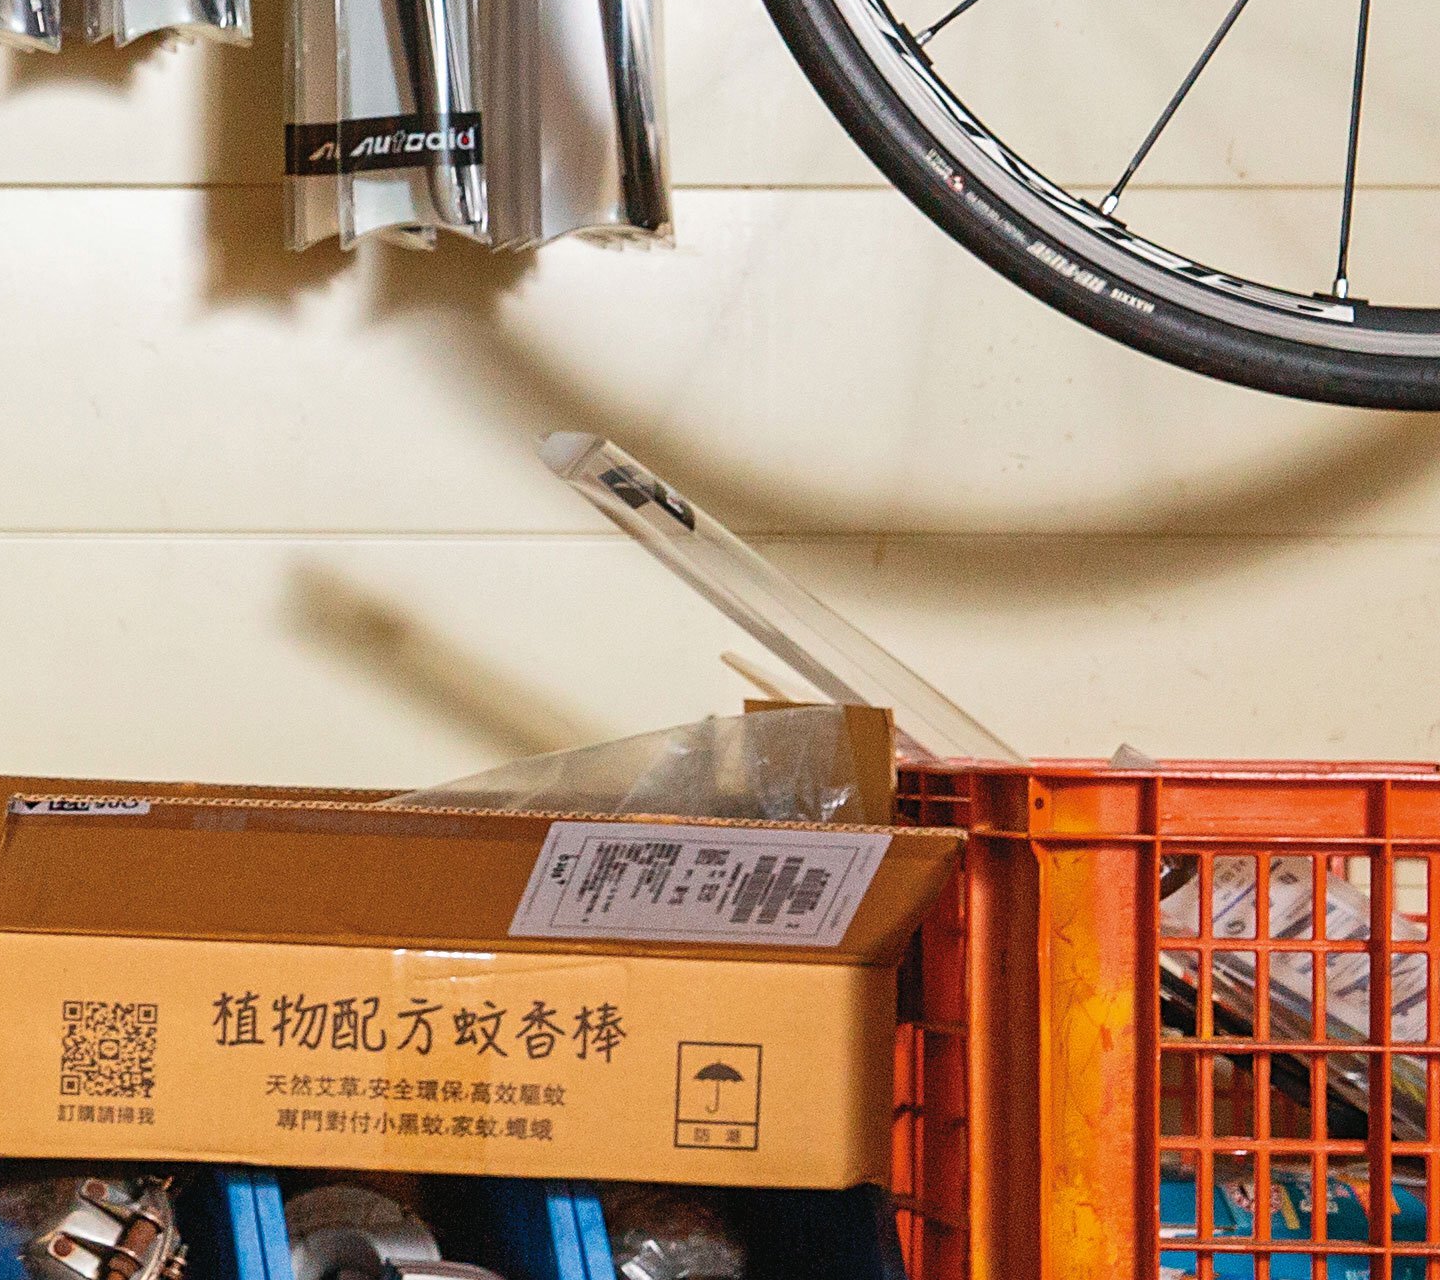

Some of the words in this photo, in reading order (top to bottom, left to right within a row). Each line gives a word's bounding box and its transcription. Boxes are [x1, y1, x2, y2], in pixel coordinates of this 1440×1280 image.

[212, 991, 627, 1064] 植物配方蚊香棒
